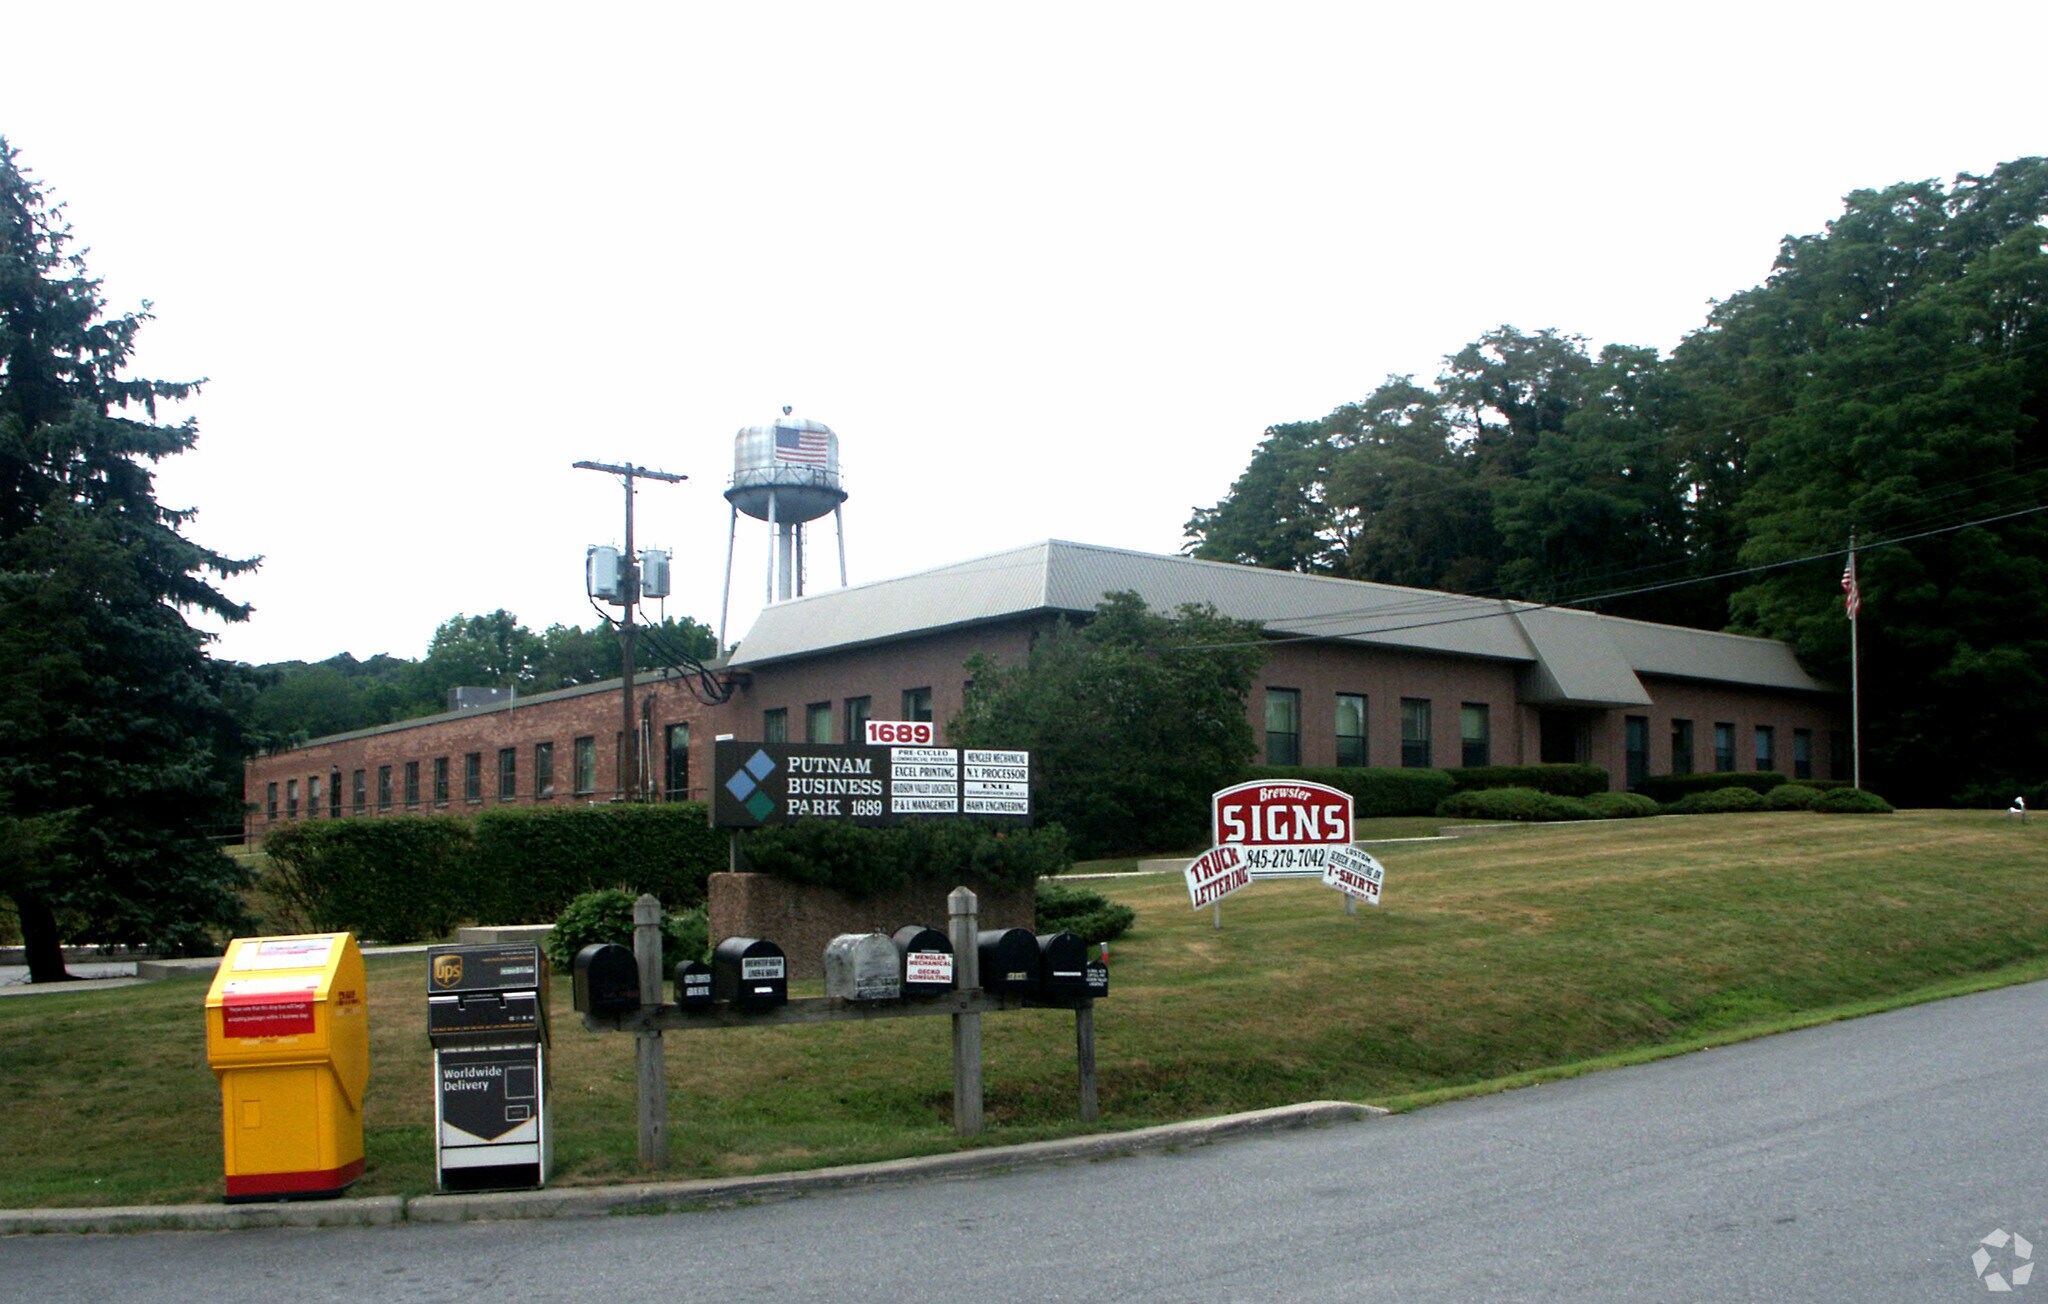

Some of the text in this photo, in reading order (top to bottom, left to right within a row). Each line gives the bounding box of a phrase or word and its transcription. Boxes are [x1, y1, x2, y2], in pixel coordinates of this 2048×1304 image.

[868, 723, 930, 743] 1689
[787, 757, 872, 774] PUTNAM
[993, 753, 1025, 764] MECHANICAL
[895, 766, 955, 777] EXCEL PRINTING
[981, 768, 1026, 779] PROCESSOR
[787, 779, 882, 795] BUSINESS
[1259, 787, 1312, 802] Brewster
[787, 799, 882, 816] PARK 1689
[894, 800, 898, 810] P
[912, 800, 955, 810] MANAGEMENT
[966, 800, 1026, 812] HAHN ENGINEERING
[1223, 805, 1345, 841] SIGNS
[1190, 847, 1240, 883] TRUCK
[1247, 848, 1325, 868] 845-279-7042
[1194, 865, 1249, 907] LETTERING
[1328, 863, 1379, 895] T-SHIRTS
[436, 965, 460, 983] ups
[443, 1065, 502, 1079] Worldwide
[443, 1080, 489, 1092] Delivery
